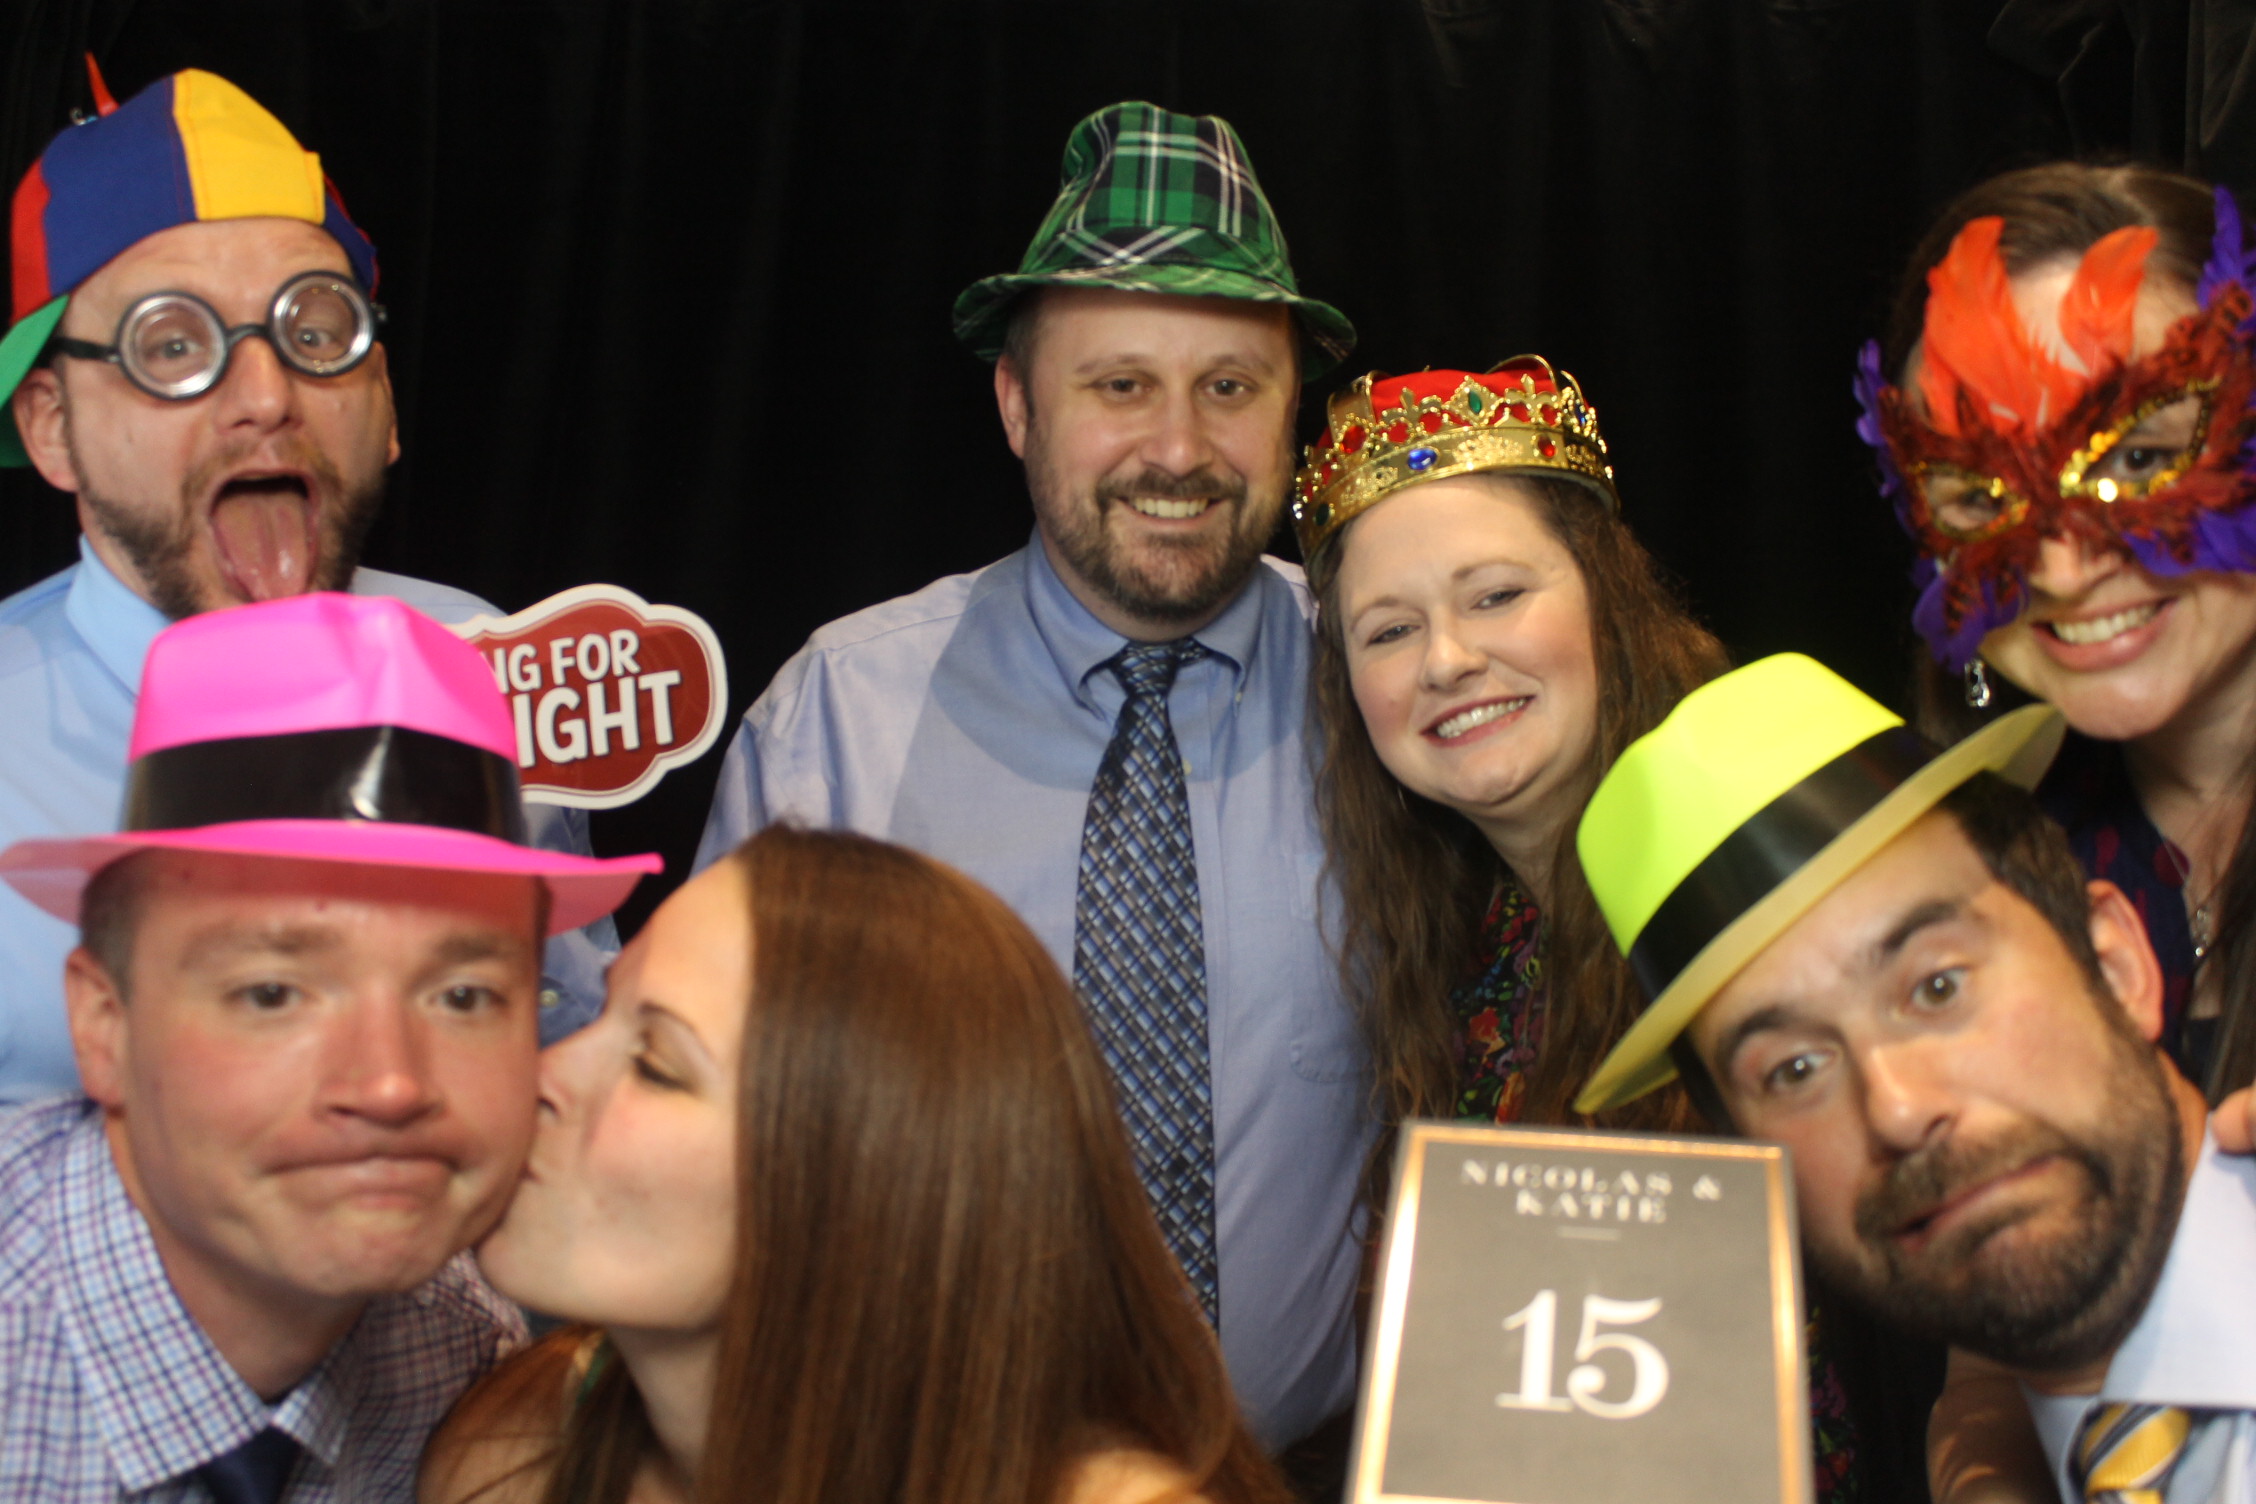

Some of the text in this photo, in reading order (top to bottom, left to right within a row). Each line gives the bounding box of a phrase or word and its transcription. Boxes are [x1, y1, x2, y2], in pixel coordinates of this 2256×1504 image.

[549, 629, 641, 686] FOR
[512, 670, 681, 768] IGHT
[1461, 1159, 1722, 1201] NICOLAS &
[1516, 1188, 1667, 1223] KATIE
[1495, 1288, 1669, 1420] 15
